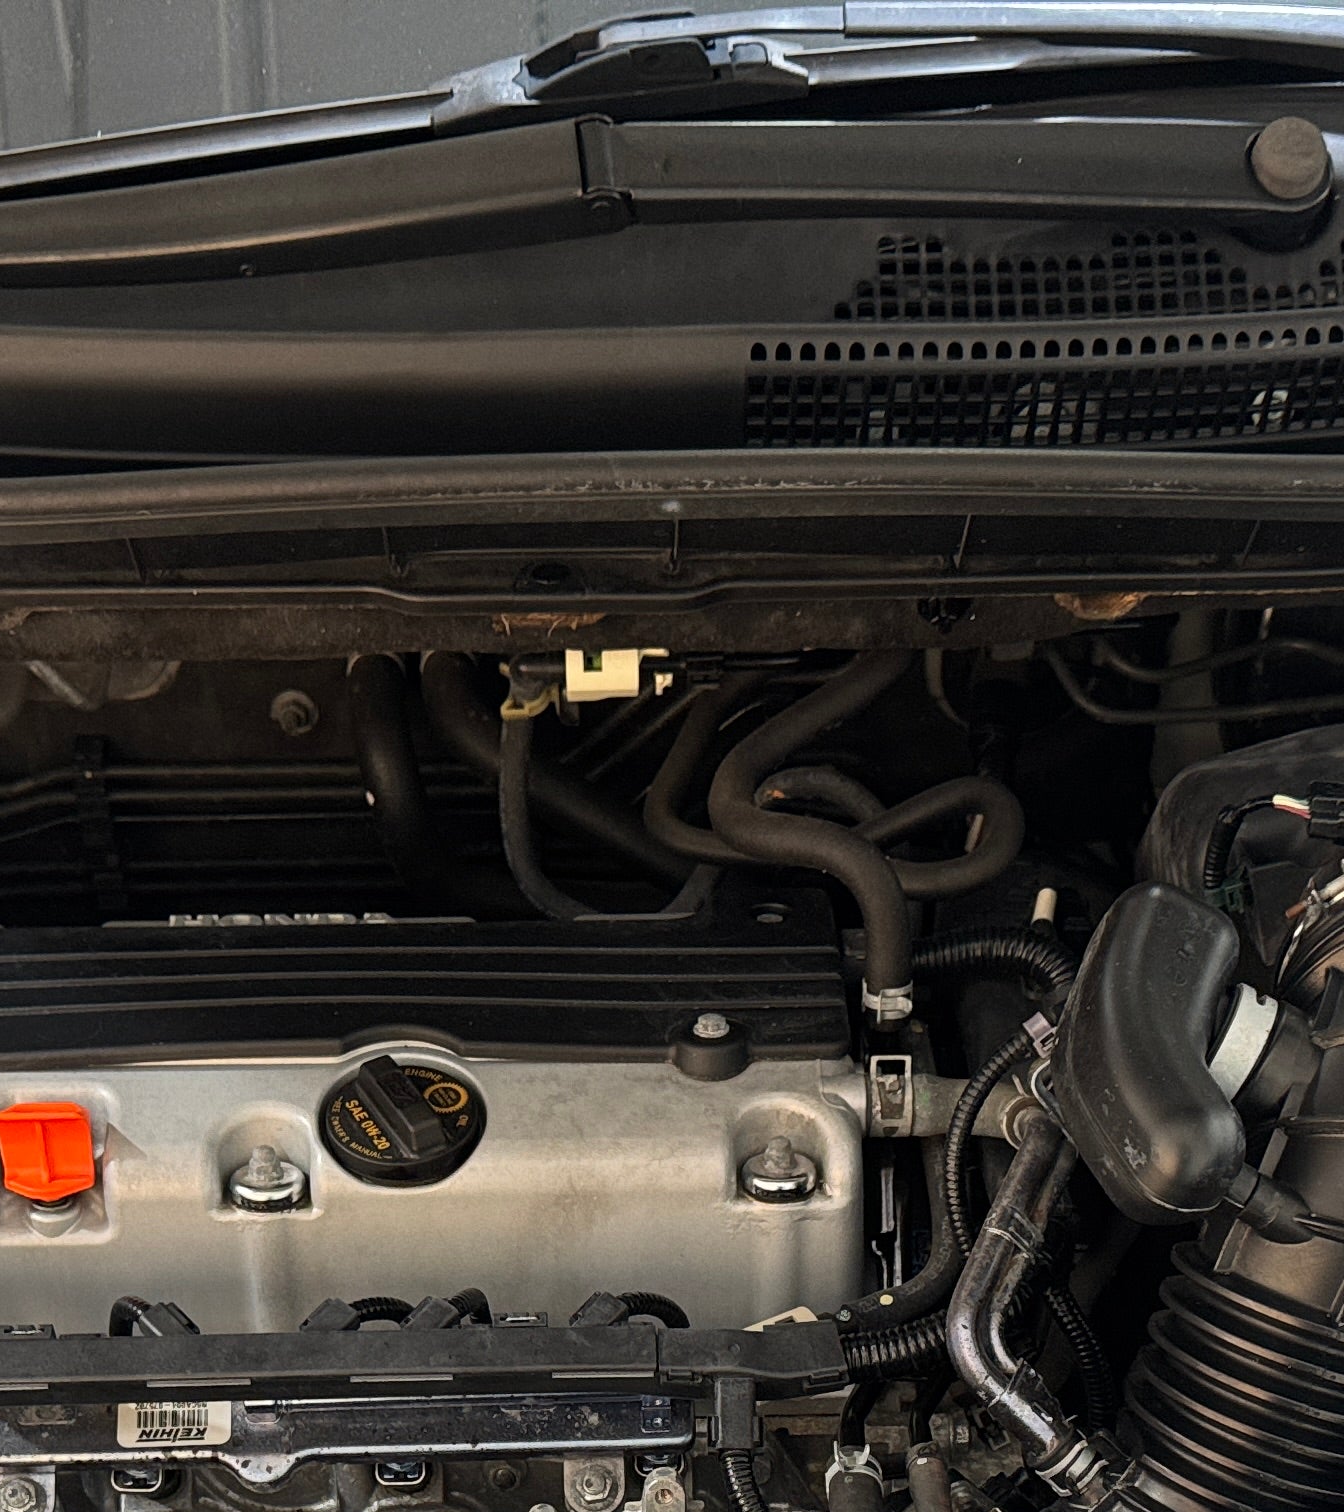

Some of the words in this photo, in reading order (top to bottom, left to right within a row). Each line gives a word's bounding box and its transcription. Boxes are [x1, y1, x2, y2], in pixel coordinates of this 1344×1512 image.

[404, 1068, 443, 1082] ENGINE
[345, 1099, 369, 1121] SAE
[361, 1120, 391, 1150] 0W-20
[349, 1142, 382, 1159] MANUAL
[136, 1427, 207, 1443] KEIHIN
